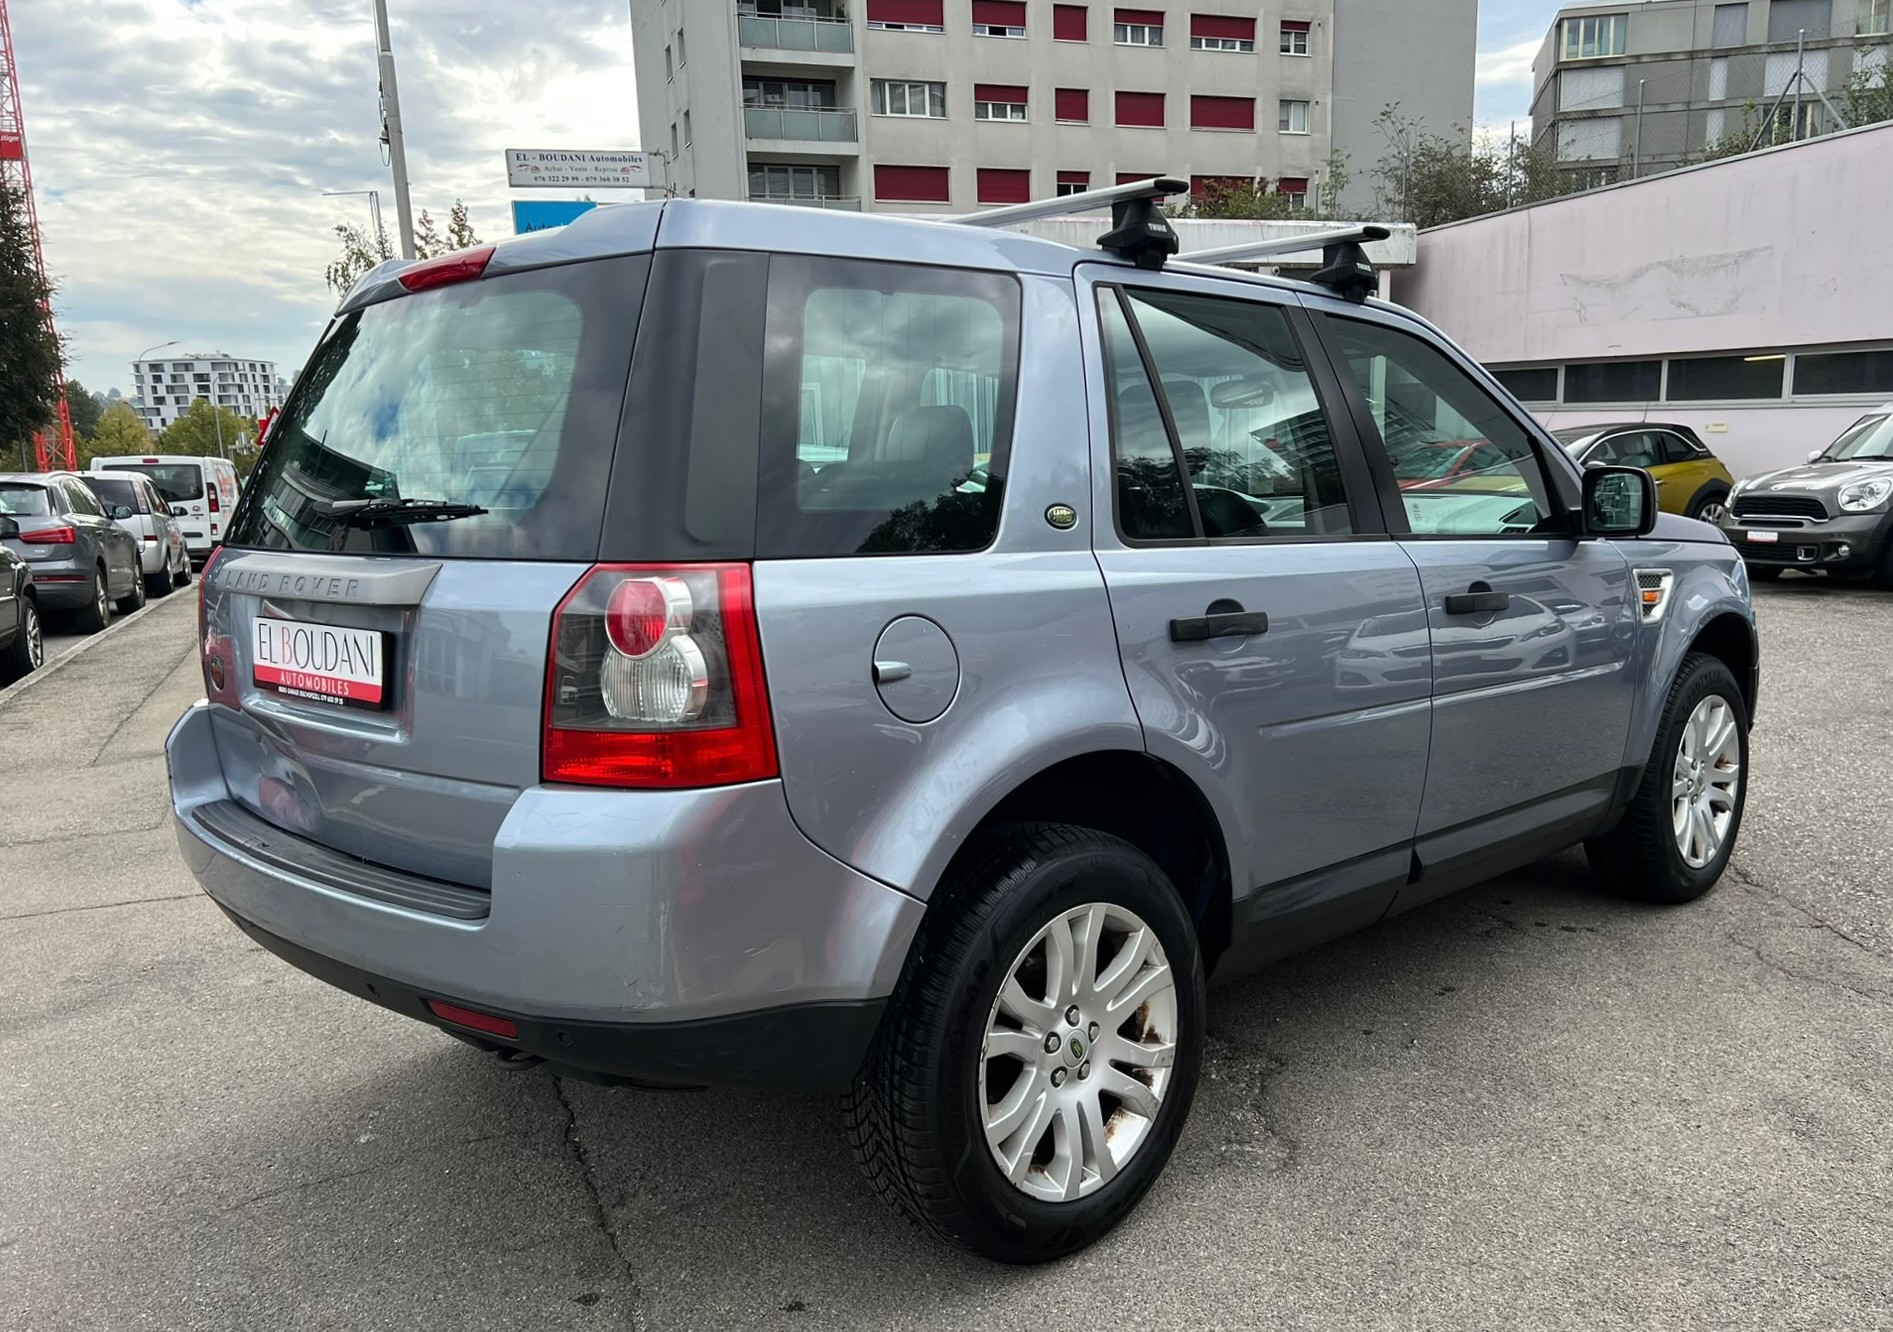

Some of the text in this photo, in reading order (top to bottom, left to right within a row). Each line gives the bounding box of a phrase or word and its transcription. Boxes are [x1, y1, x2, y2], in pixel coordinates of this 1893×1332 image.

[516, 153, 529, 161] EL
[539, 153, 585, 162] BOUDANI
[589, 154, 643, 163] Automobiles
[1147, 222, 1167, 232] THULE
[225, 570, 360, 597] LAND ROVER
[258, 623, 375, 677] EL BOUDANI
[280, 670, 349, 695] AUTOMOBILES
